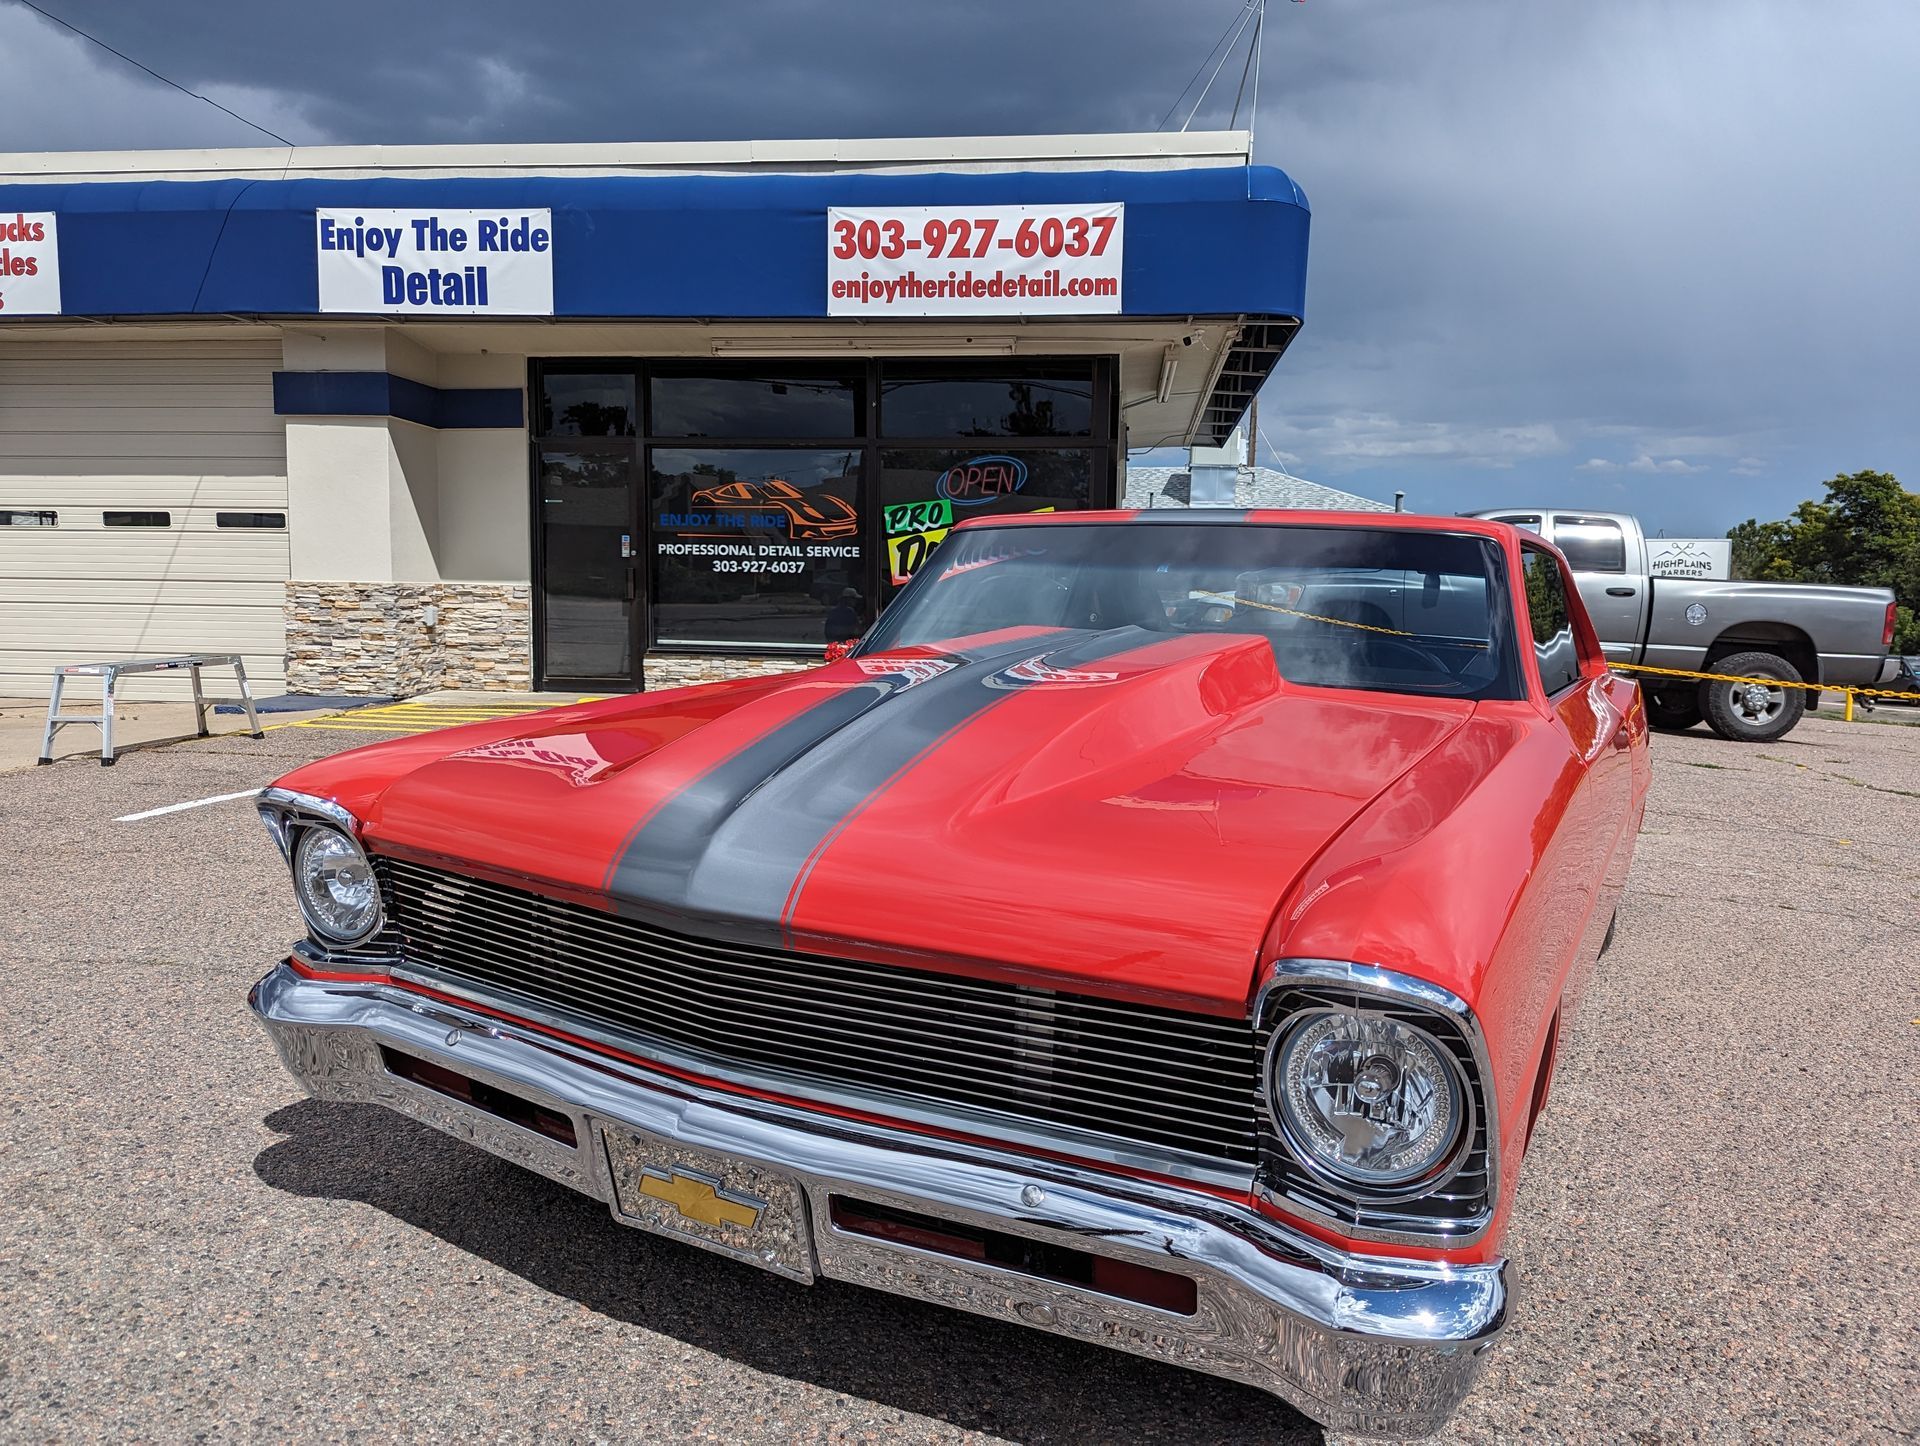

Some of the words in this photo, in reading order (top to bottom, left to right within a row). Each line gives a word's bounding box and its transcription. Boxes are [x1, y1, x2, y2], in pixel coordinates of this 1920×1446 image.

[320, 217, 402, 258] Enjoy
[411, 217, 467, 252] The
[478, 217, 549, 252] Ride
[833, 216, 1118, 259] 303-927-6037
[382, 265, 488, 305] Detail
[831, 270, 1117, 303] enjoytheridedetail.com
[947, 466, 1014, 496] OPEN
[660, 513, 711, 527] ENJOY
[716, 514, 745, 527] THE
[751, 515, 785, 528] RIDE
[885, 502, 944, 534] PRO
[658, 543, 754, 556] PROFESSIONAL
[759, 545, 803, 557] DETAIL
[807, 546, 860, 558] SERVICE
[712, 560, 805, 573] 303-927-6037
[1661, 569, 1703, 577] BARBERS
